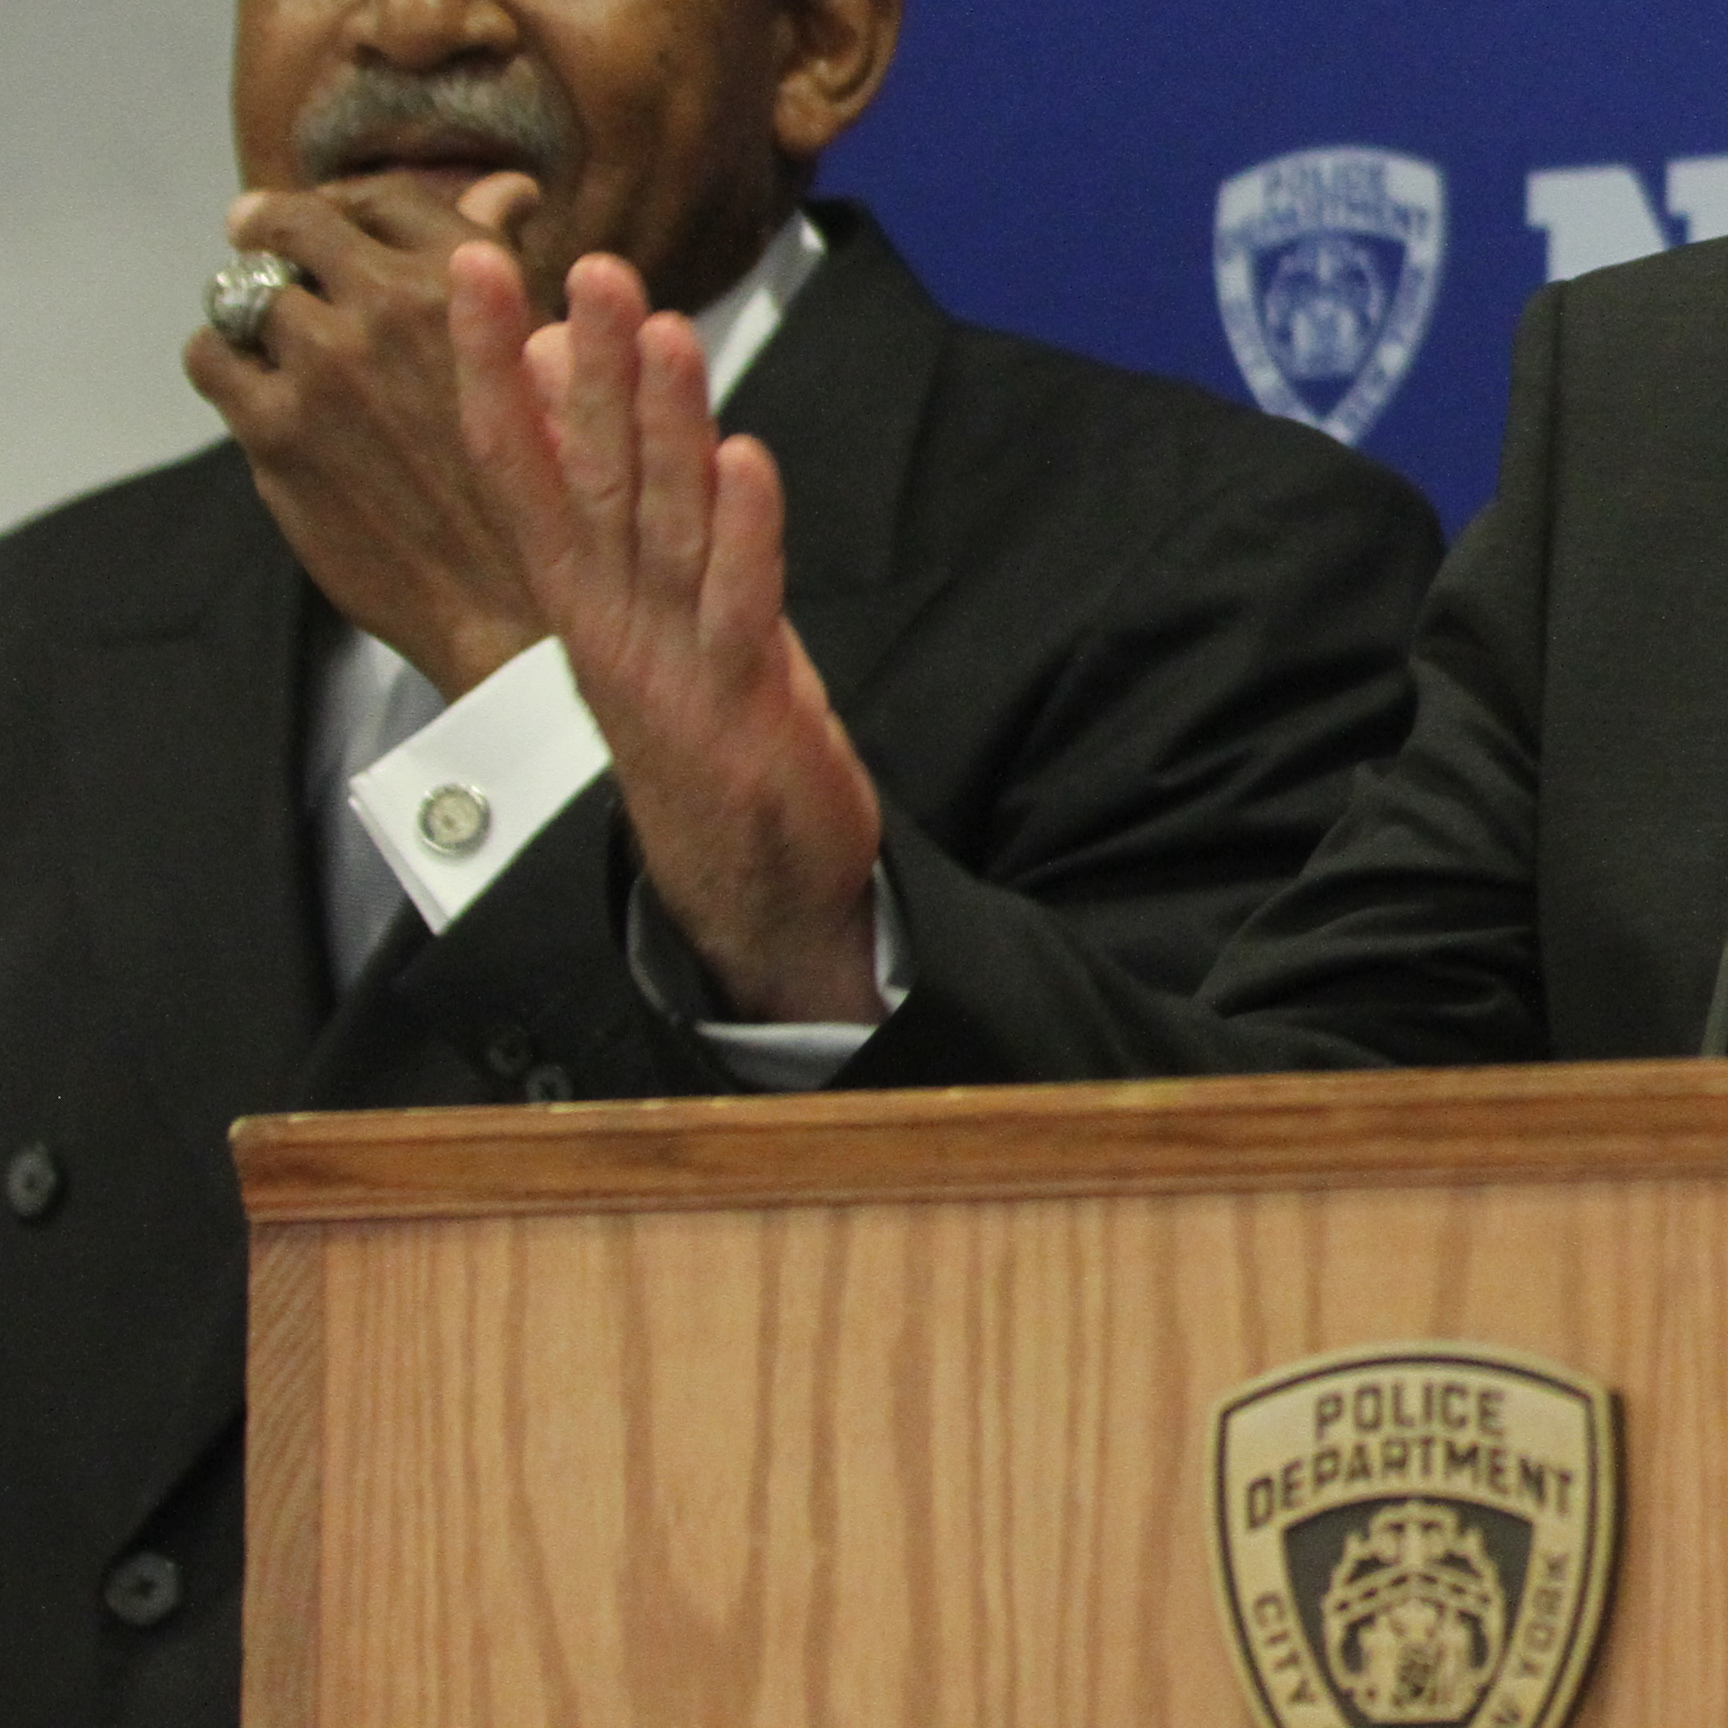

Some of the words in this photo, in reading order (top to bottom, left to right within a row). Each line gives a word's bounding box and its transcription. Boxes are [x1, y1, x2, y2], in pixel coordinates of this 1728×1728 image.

[1315, 1381, 1506, 1439] POLICE
[1246, 1436, 1573, 1530] DEPARTMENT
[1253, 1593, 1317, 1705] CITY
